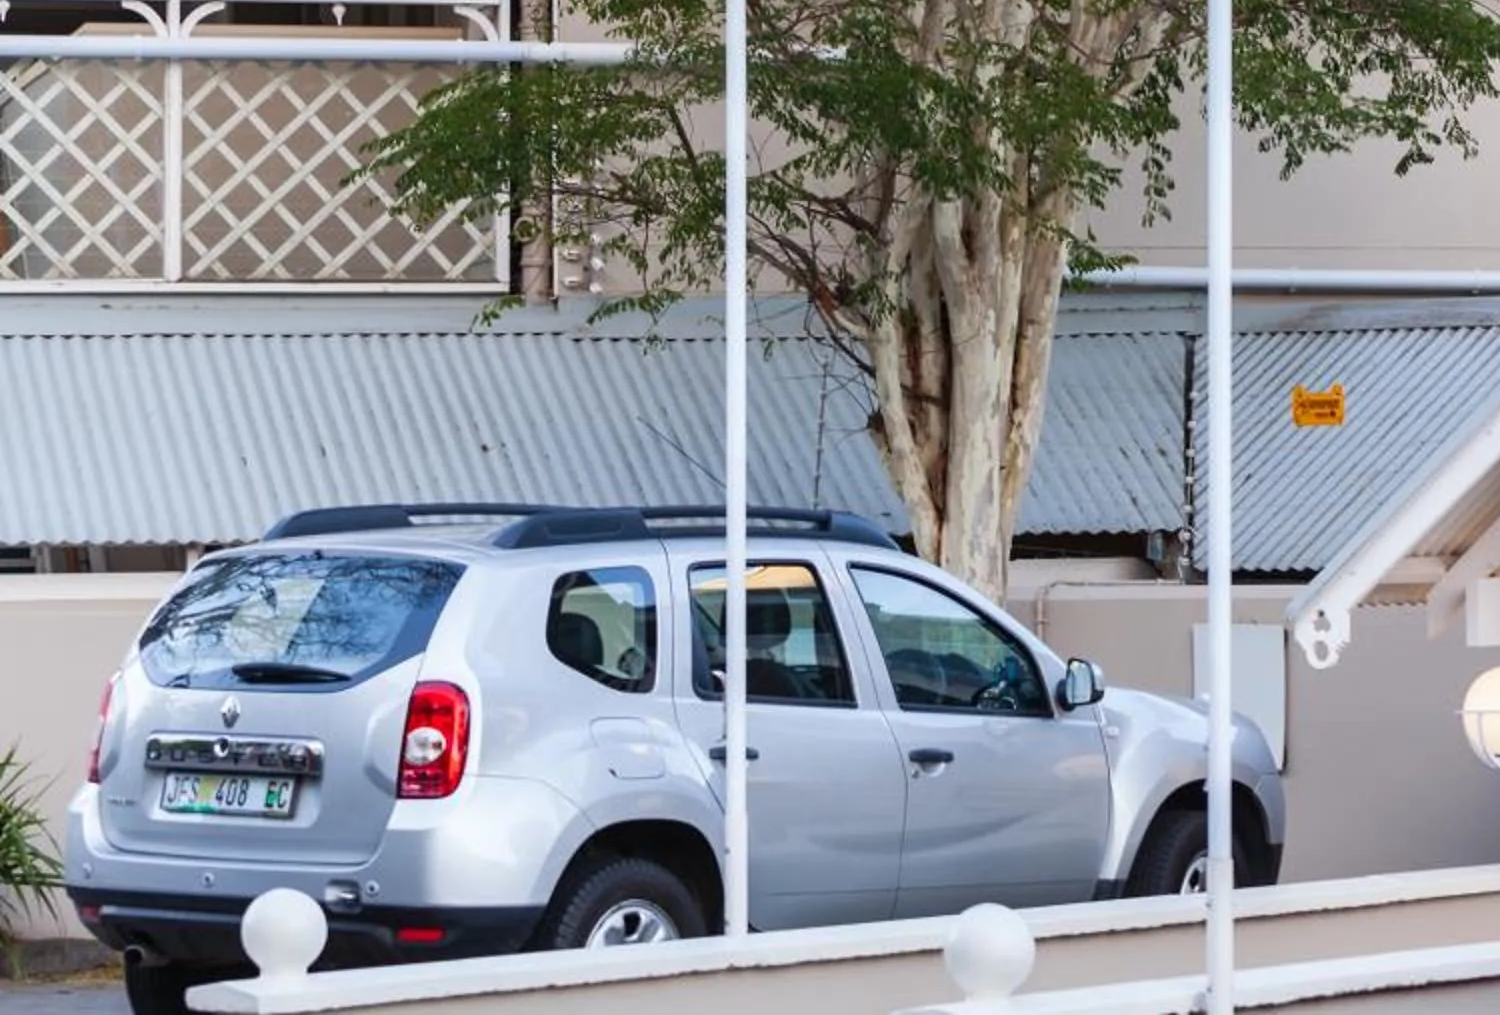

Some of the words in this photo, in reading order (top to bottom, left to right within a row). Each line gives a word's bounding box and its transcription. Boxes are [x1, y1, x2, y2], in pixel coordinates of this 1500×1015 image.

[167, 776, 200, 804] JFS
[215, 778, 248, 807] 408
[264, 781, 290, 809] EC
